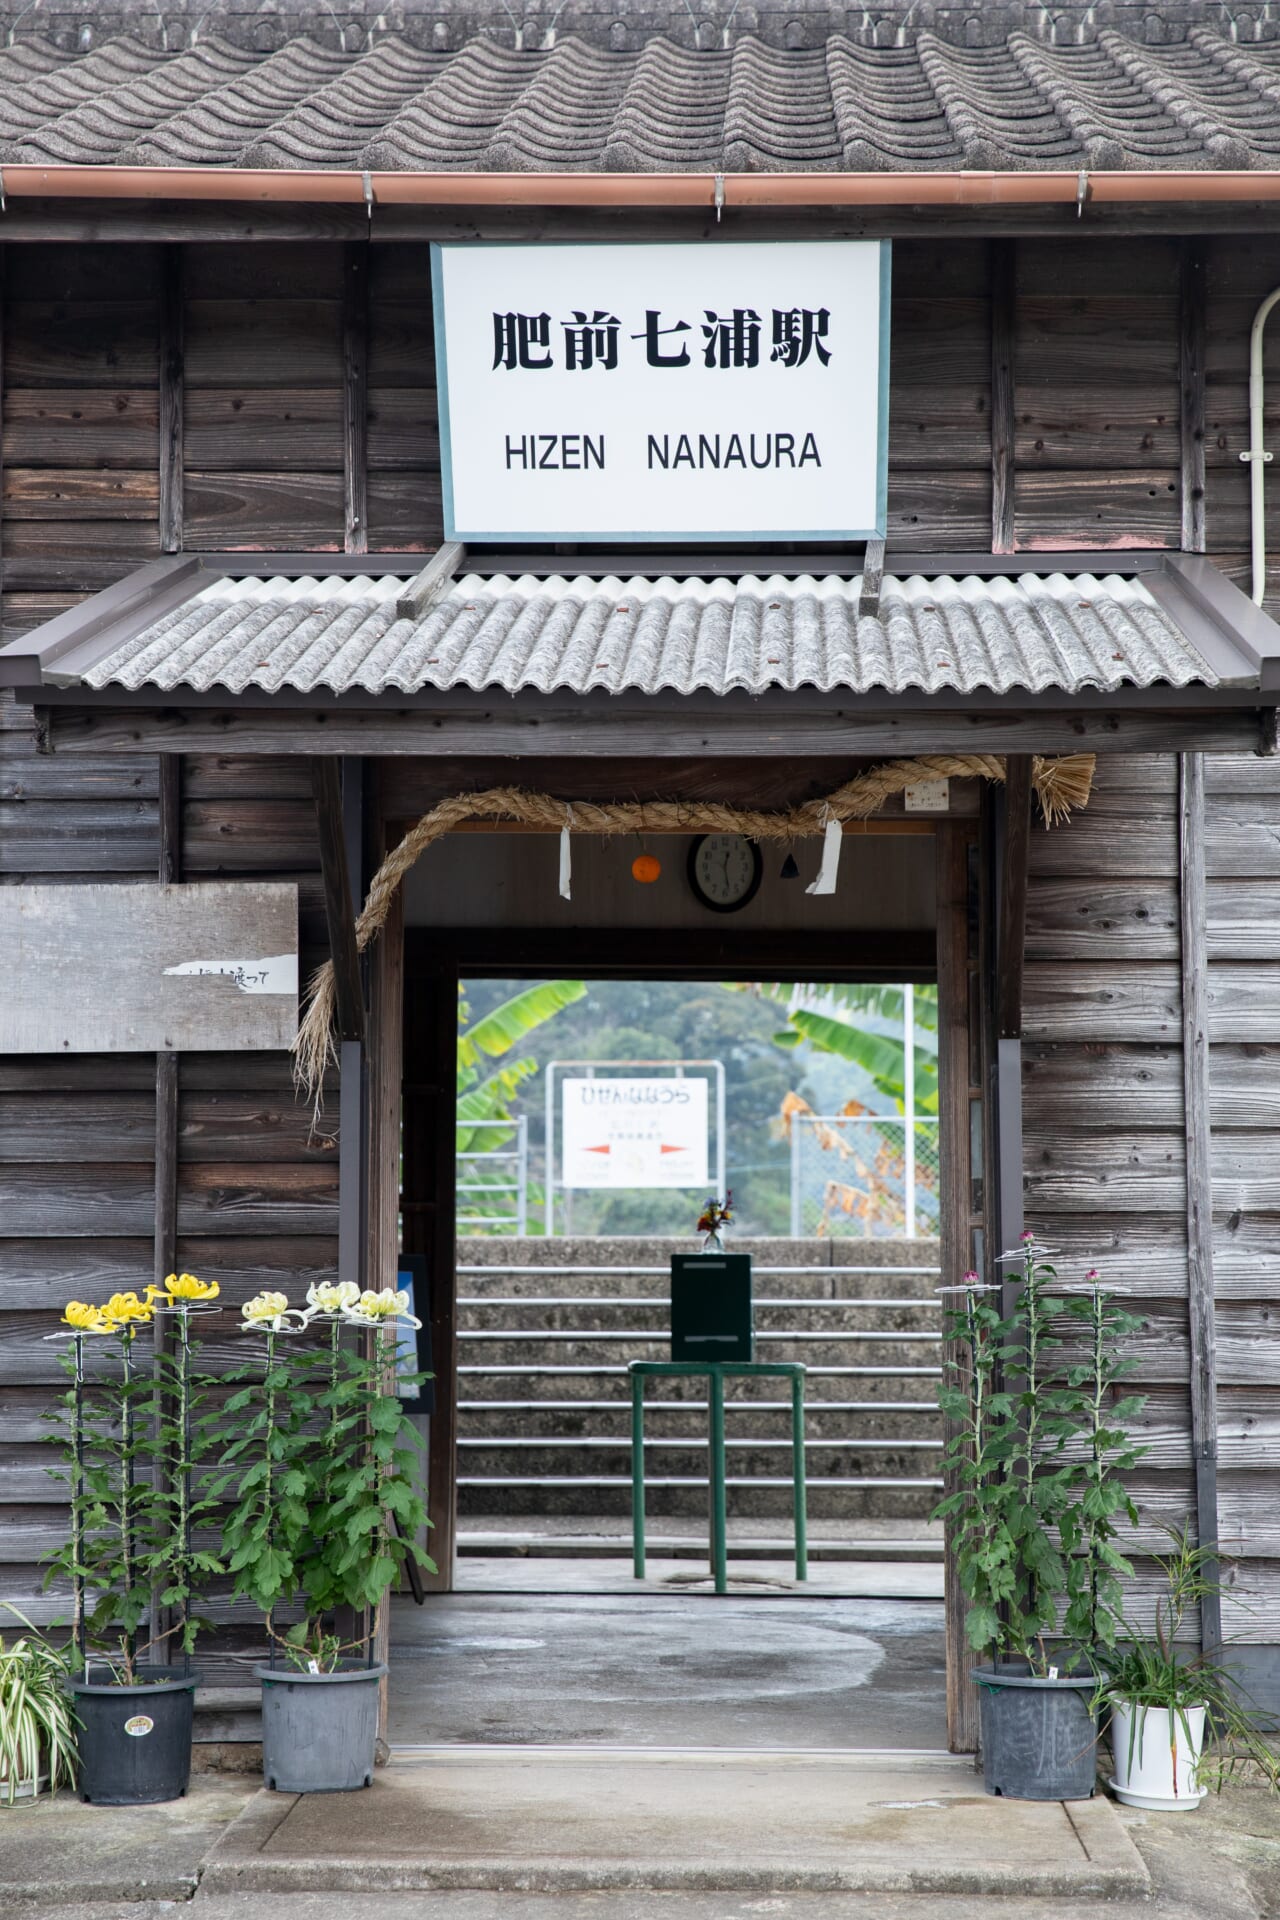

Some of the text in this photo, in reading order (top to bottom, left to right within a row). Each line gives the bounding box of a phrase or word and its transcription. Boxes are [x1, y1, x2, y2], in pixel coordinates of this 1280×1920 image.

[492, 307, 833, 371] 肥前七浦駅
[505, 432, 822, 470] HIZEN NANAURA
